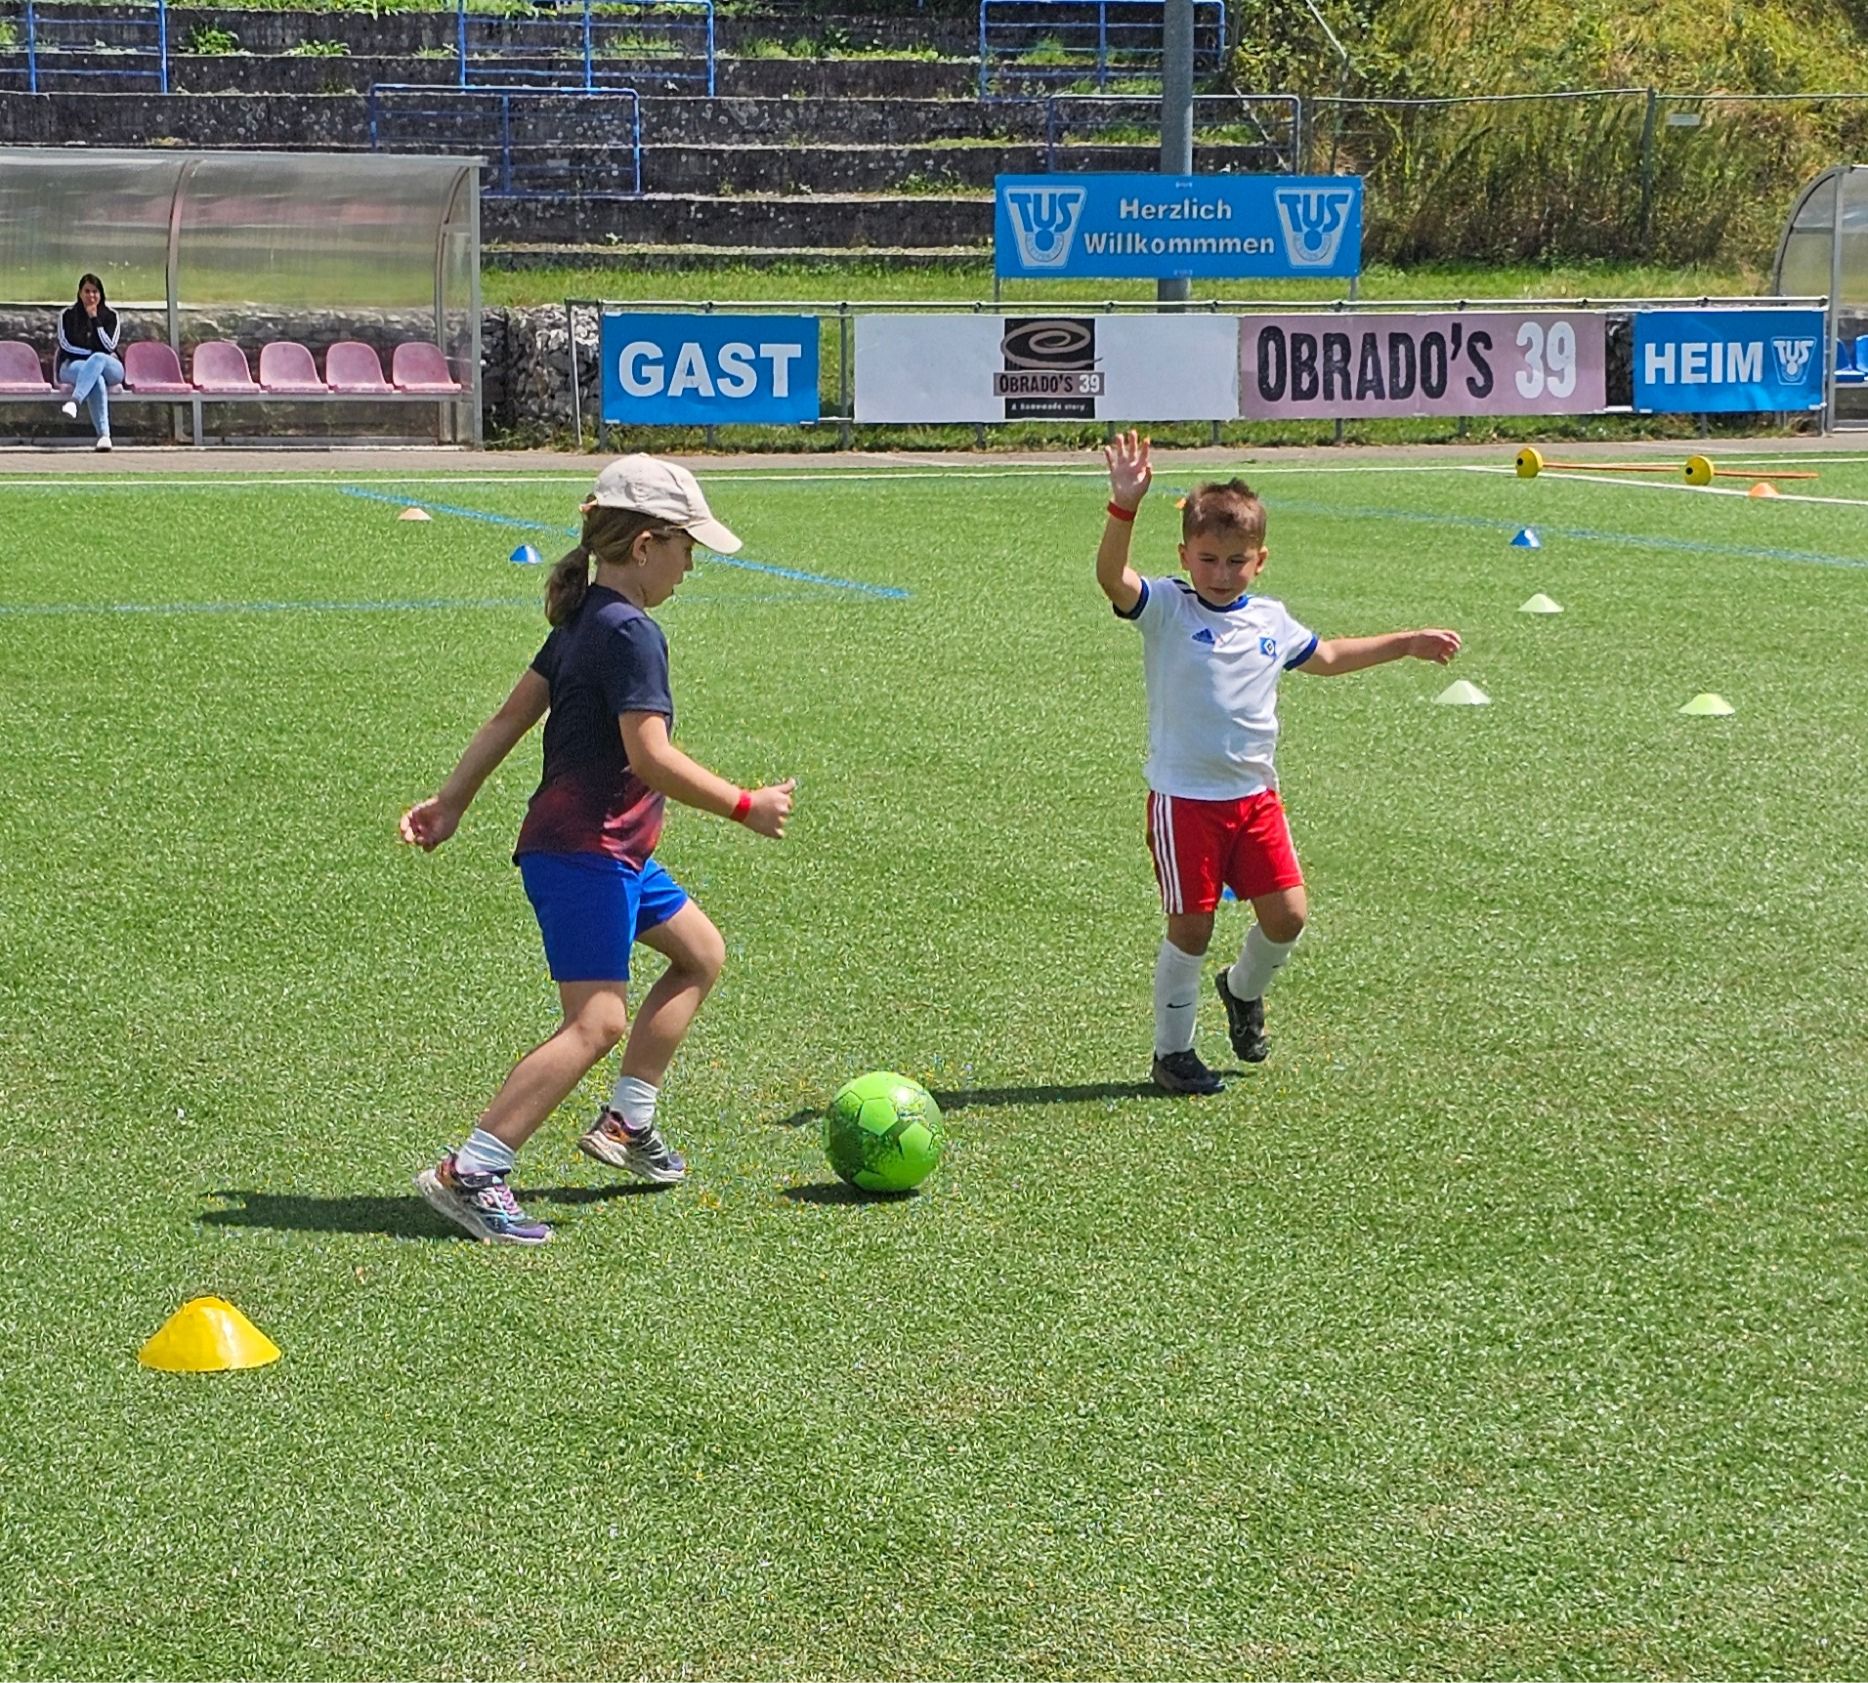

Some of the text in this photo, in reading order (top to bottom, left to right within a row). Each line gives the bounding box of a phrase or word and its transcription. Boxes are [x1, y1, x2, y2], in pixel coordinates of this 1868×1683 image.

[1009, 193, 1081, 232] TUS
[1119, 198, 1232, 220] Herzlich
[1279, 194, 1349, 232] TUS
[1083, 232, 1275, 255] Willkommmen
[618, 342, 802, 399] GAST
[1257, 321, 1578, 402] OBRADO'S 39
[1644, 341, 1763, 385] HEIM
[1773, 340, 1815, 365] TUS
[999, 373, 1100, 393] OBRADO'S 39
